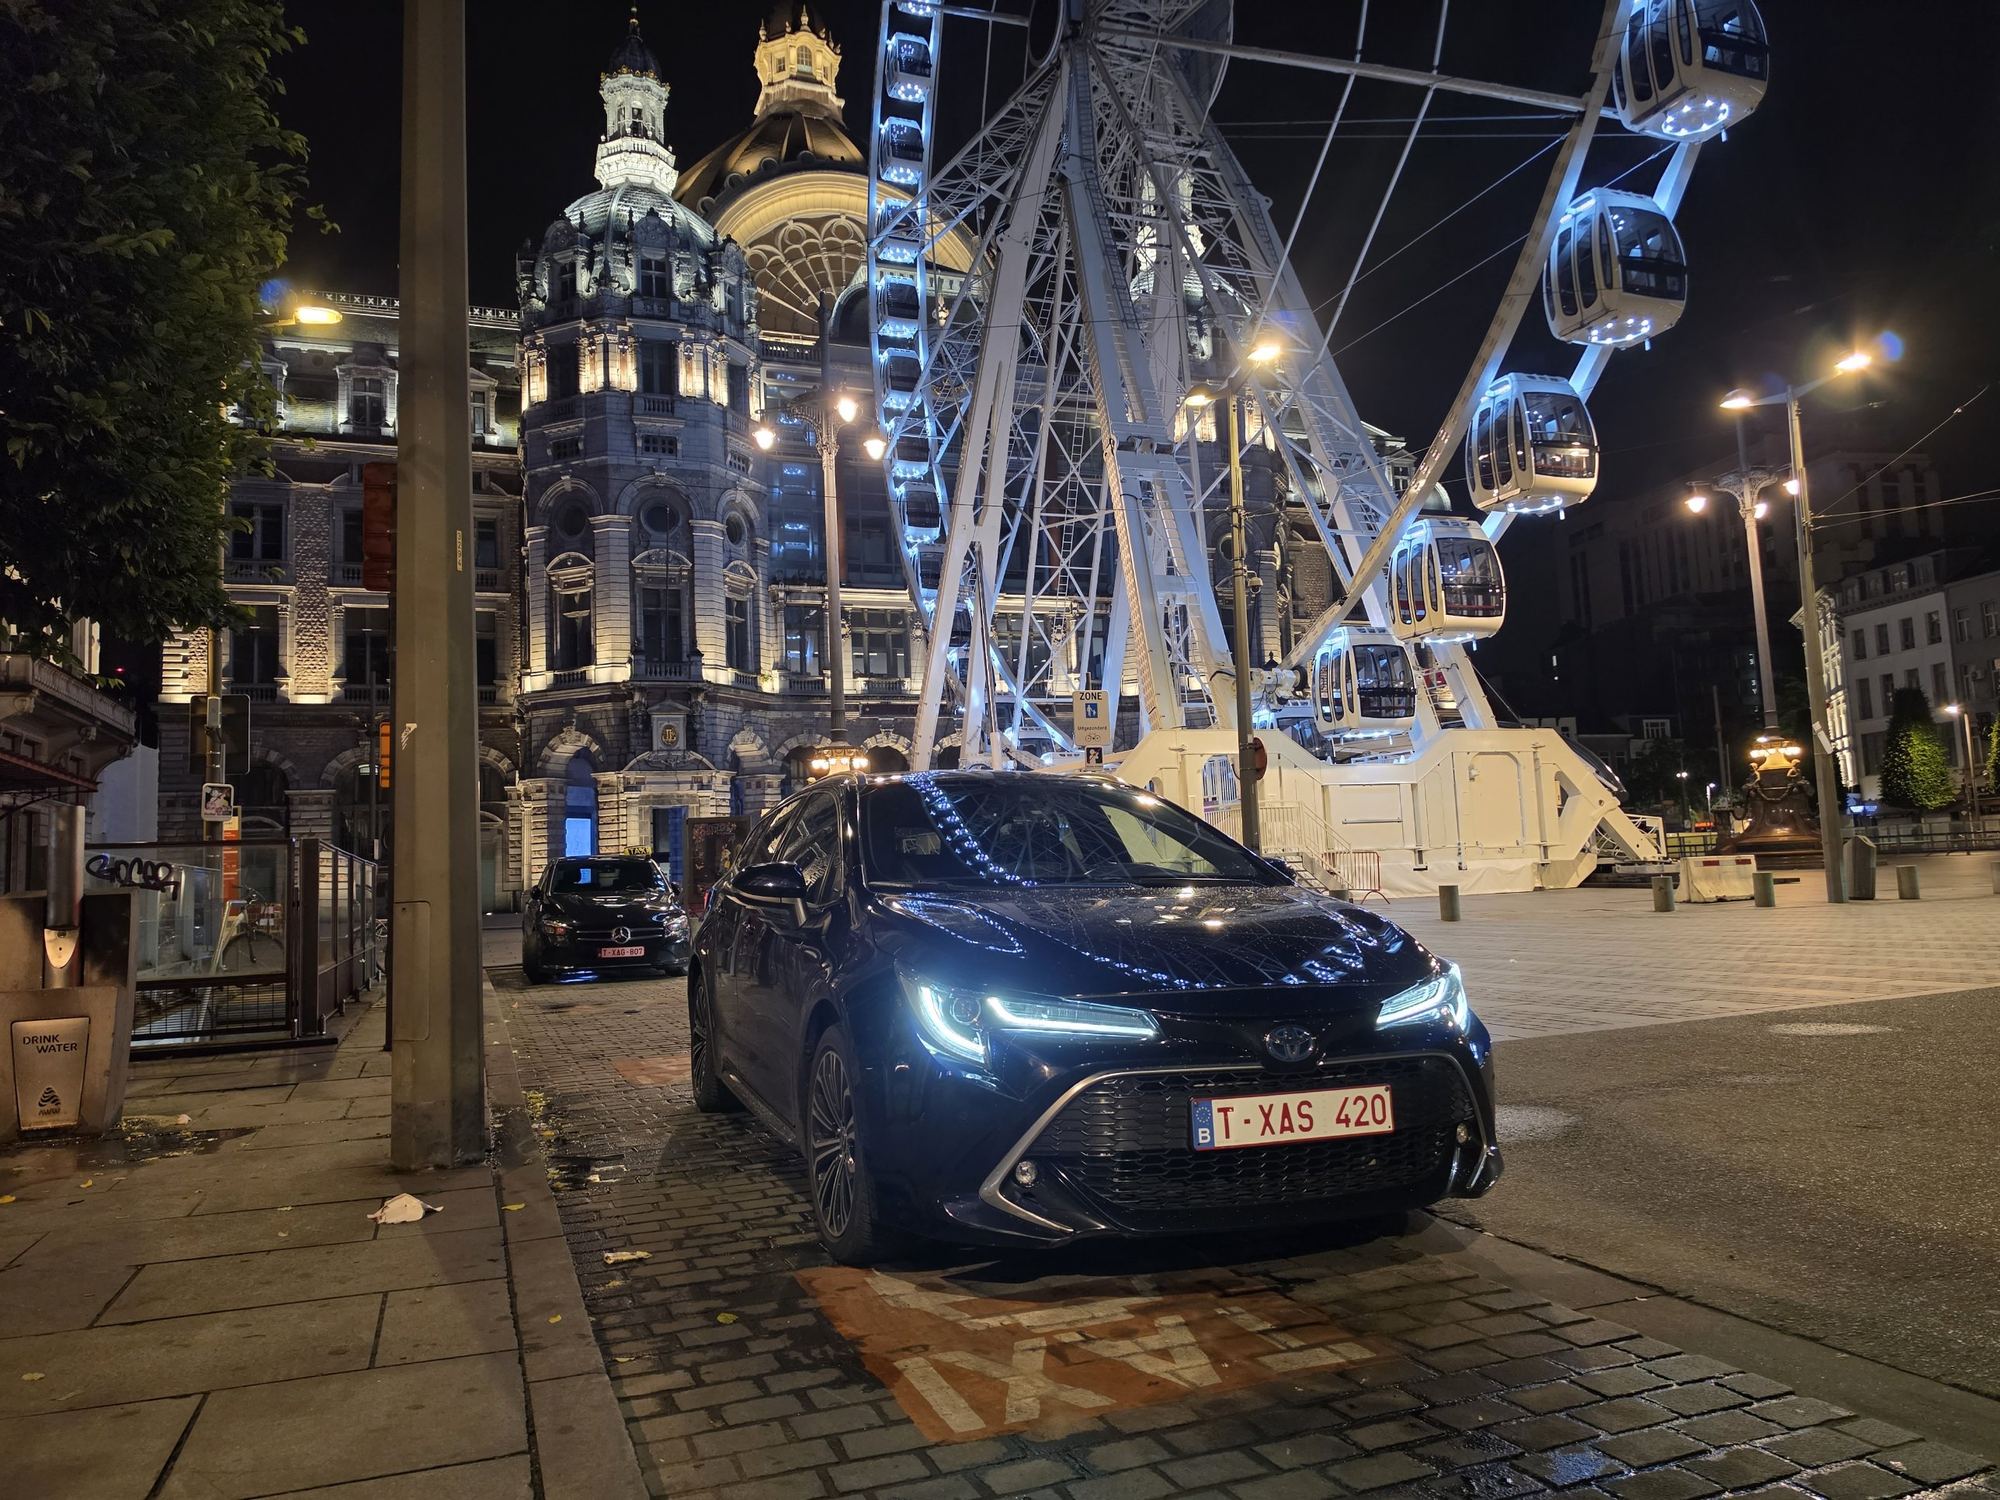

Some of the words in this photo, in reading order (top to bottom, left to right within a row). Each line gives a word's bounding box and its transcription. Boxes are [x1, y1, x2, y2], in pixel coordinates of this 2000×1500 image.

[1079, 692, 1103, 701] ZONE
[23, 1034, 60, 1045] DRINK
[36, 1042, 78, 1054] WATER
[1335, 1093, 1387, 1128] 420
[1198, 1128, 1211, 1143] B
[893, 1306, 1376, 1433] TAXI
